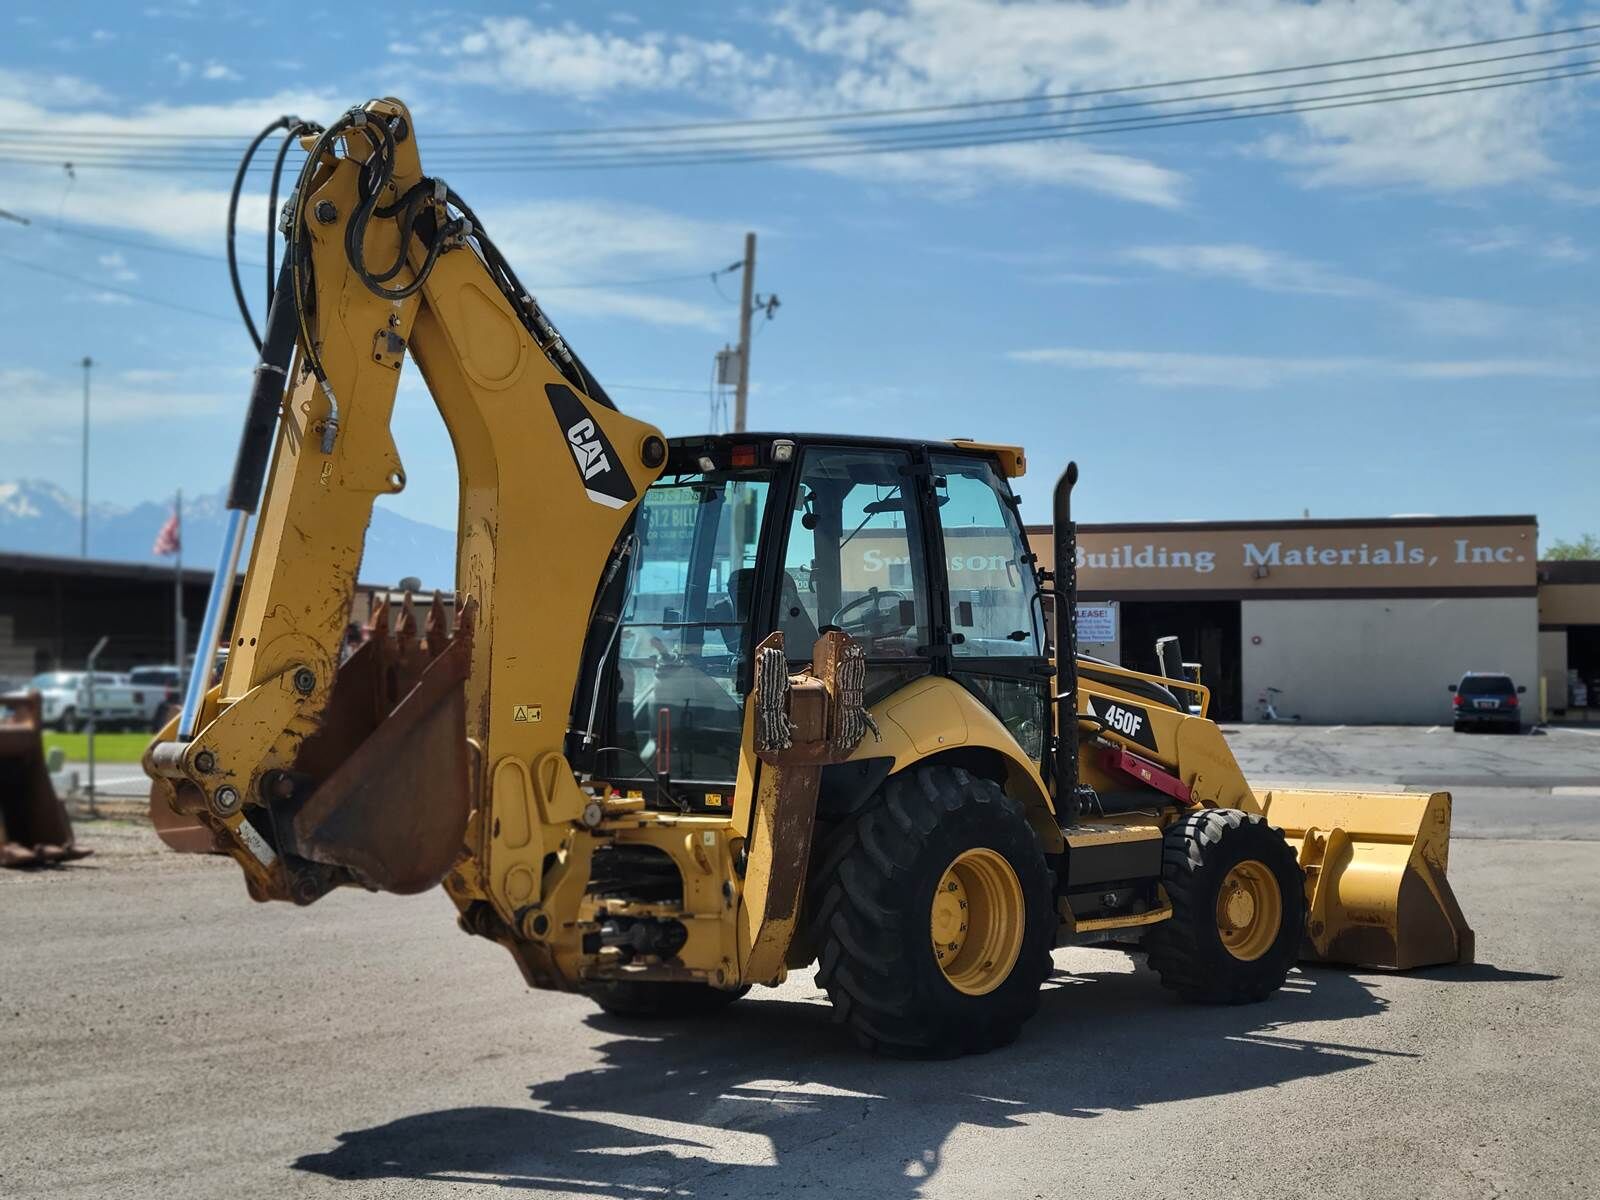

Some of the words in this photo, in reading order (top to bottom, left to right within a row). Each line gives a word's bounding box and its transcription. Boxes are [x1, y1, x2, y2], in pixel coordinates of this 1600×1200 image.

[567, 418, 611, 481] CAT
[1075, 544, 1216, 573] Building
[1243, 540, 1439, 567] Materials,
[1453, 539, 1526, 564] Inc.
[1076, 610, 1108, 618] LEASE!
[1105, 704, 1143, 737] 450F
